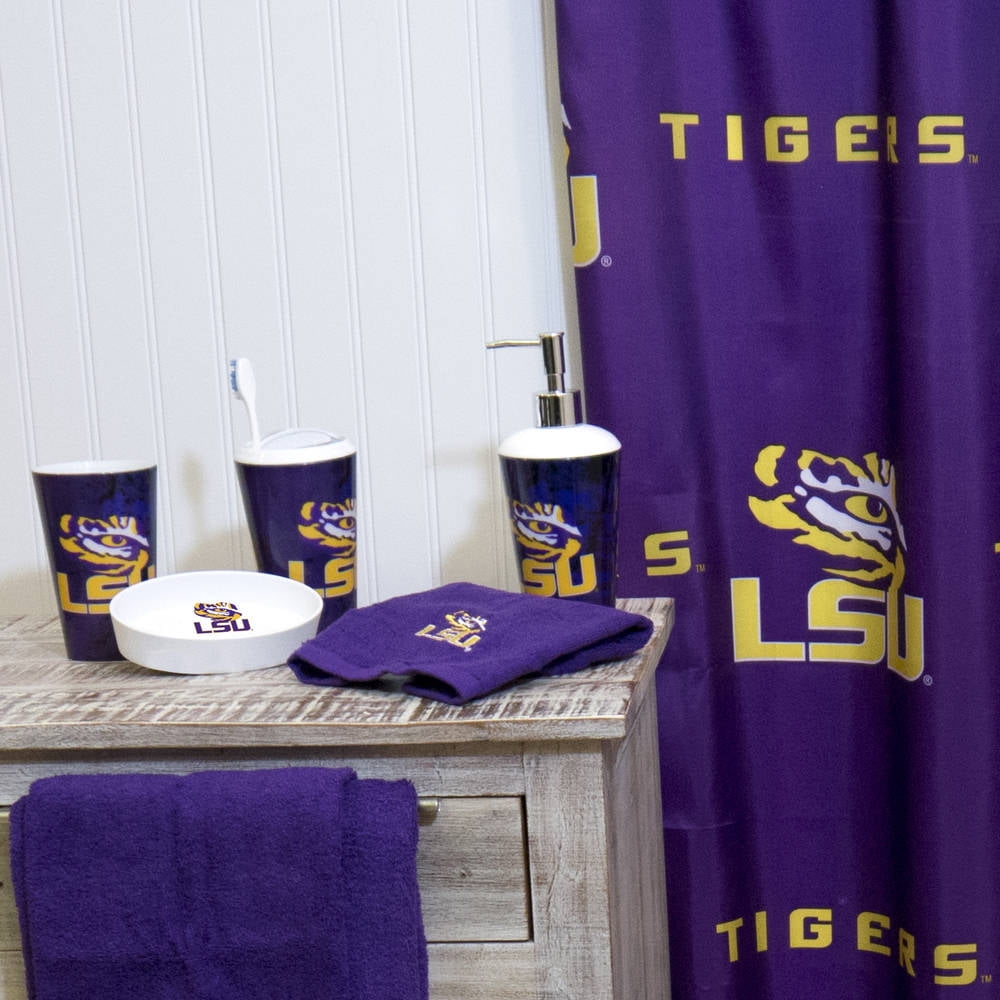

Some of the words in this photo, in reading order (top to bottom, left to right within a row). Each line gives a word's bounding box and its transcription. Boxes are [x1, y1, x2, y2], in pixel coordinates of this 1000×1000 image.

[659, 113, 966, 164] TIGERS
[519, 553, 598, 598] SU
[193, 618, 252, 635] LSU
[730, 576, 925, 682] LSU
[716, 908, 977, 986] TIGERS
